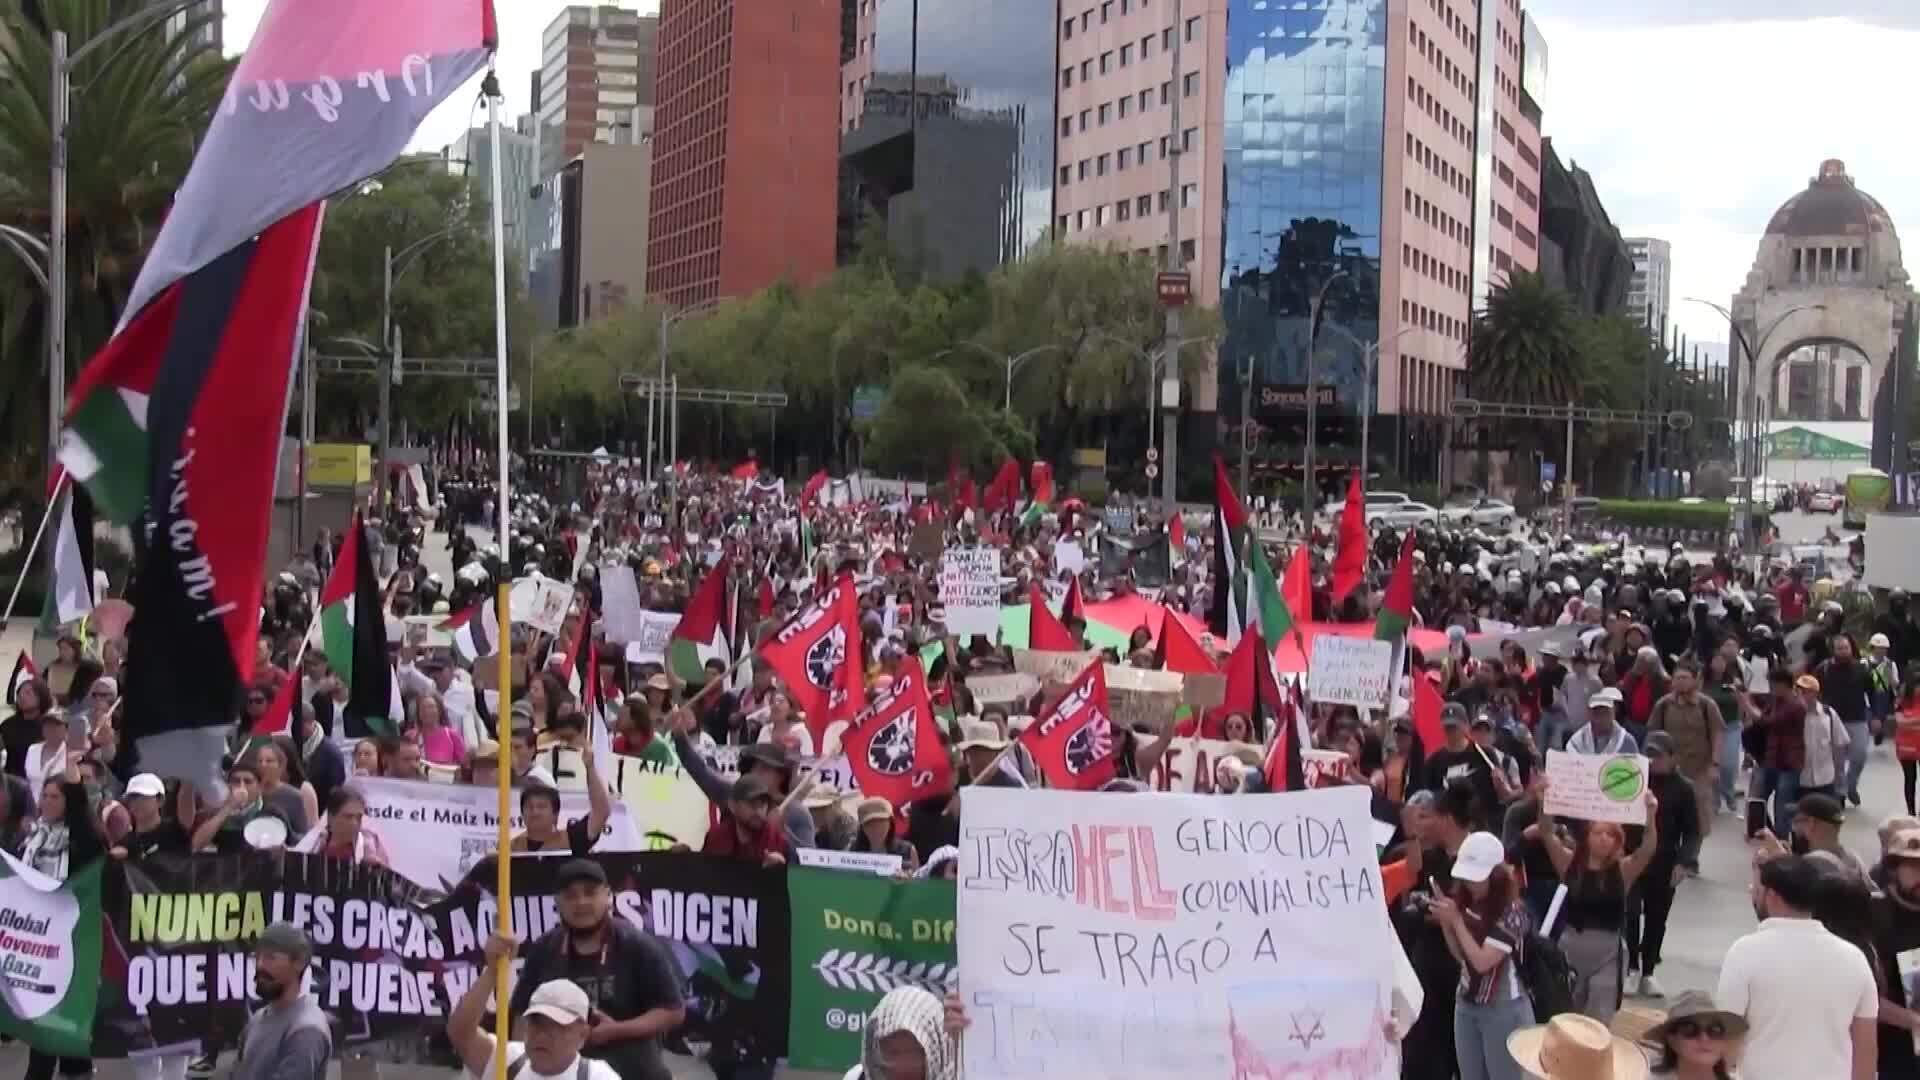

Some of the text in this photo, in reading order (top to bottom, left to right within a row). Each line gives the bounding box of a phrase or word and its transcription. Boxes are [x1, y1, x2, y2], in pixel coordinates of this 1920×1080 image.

[364, 804, 404, 819] esde
[410, 808, 426, 822] el
[434, 808, 477, 826] Maíz
[130, 891, 265, 942] NUNCA
[342, 899, 445, 960] CREAS
[450, 907, 475, 955] A
[651, 888, 758, 948] DICEN
[824, 908, 903, 940] Dona.
[1003, 921, 1278, 988] SE TRAGÓ A
[127, 954, 207, 1015] QUE
[329, 959, 442, 1016] PUEDE
